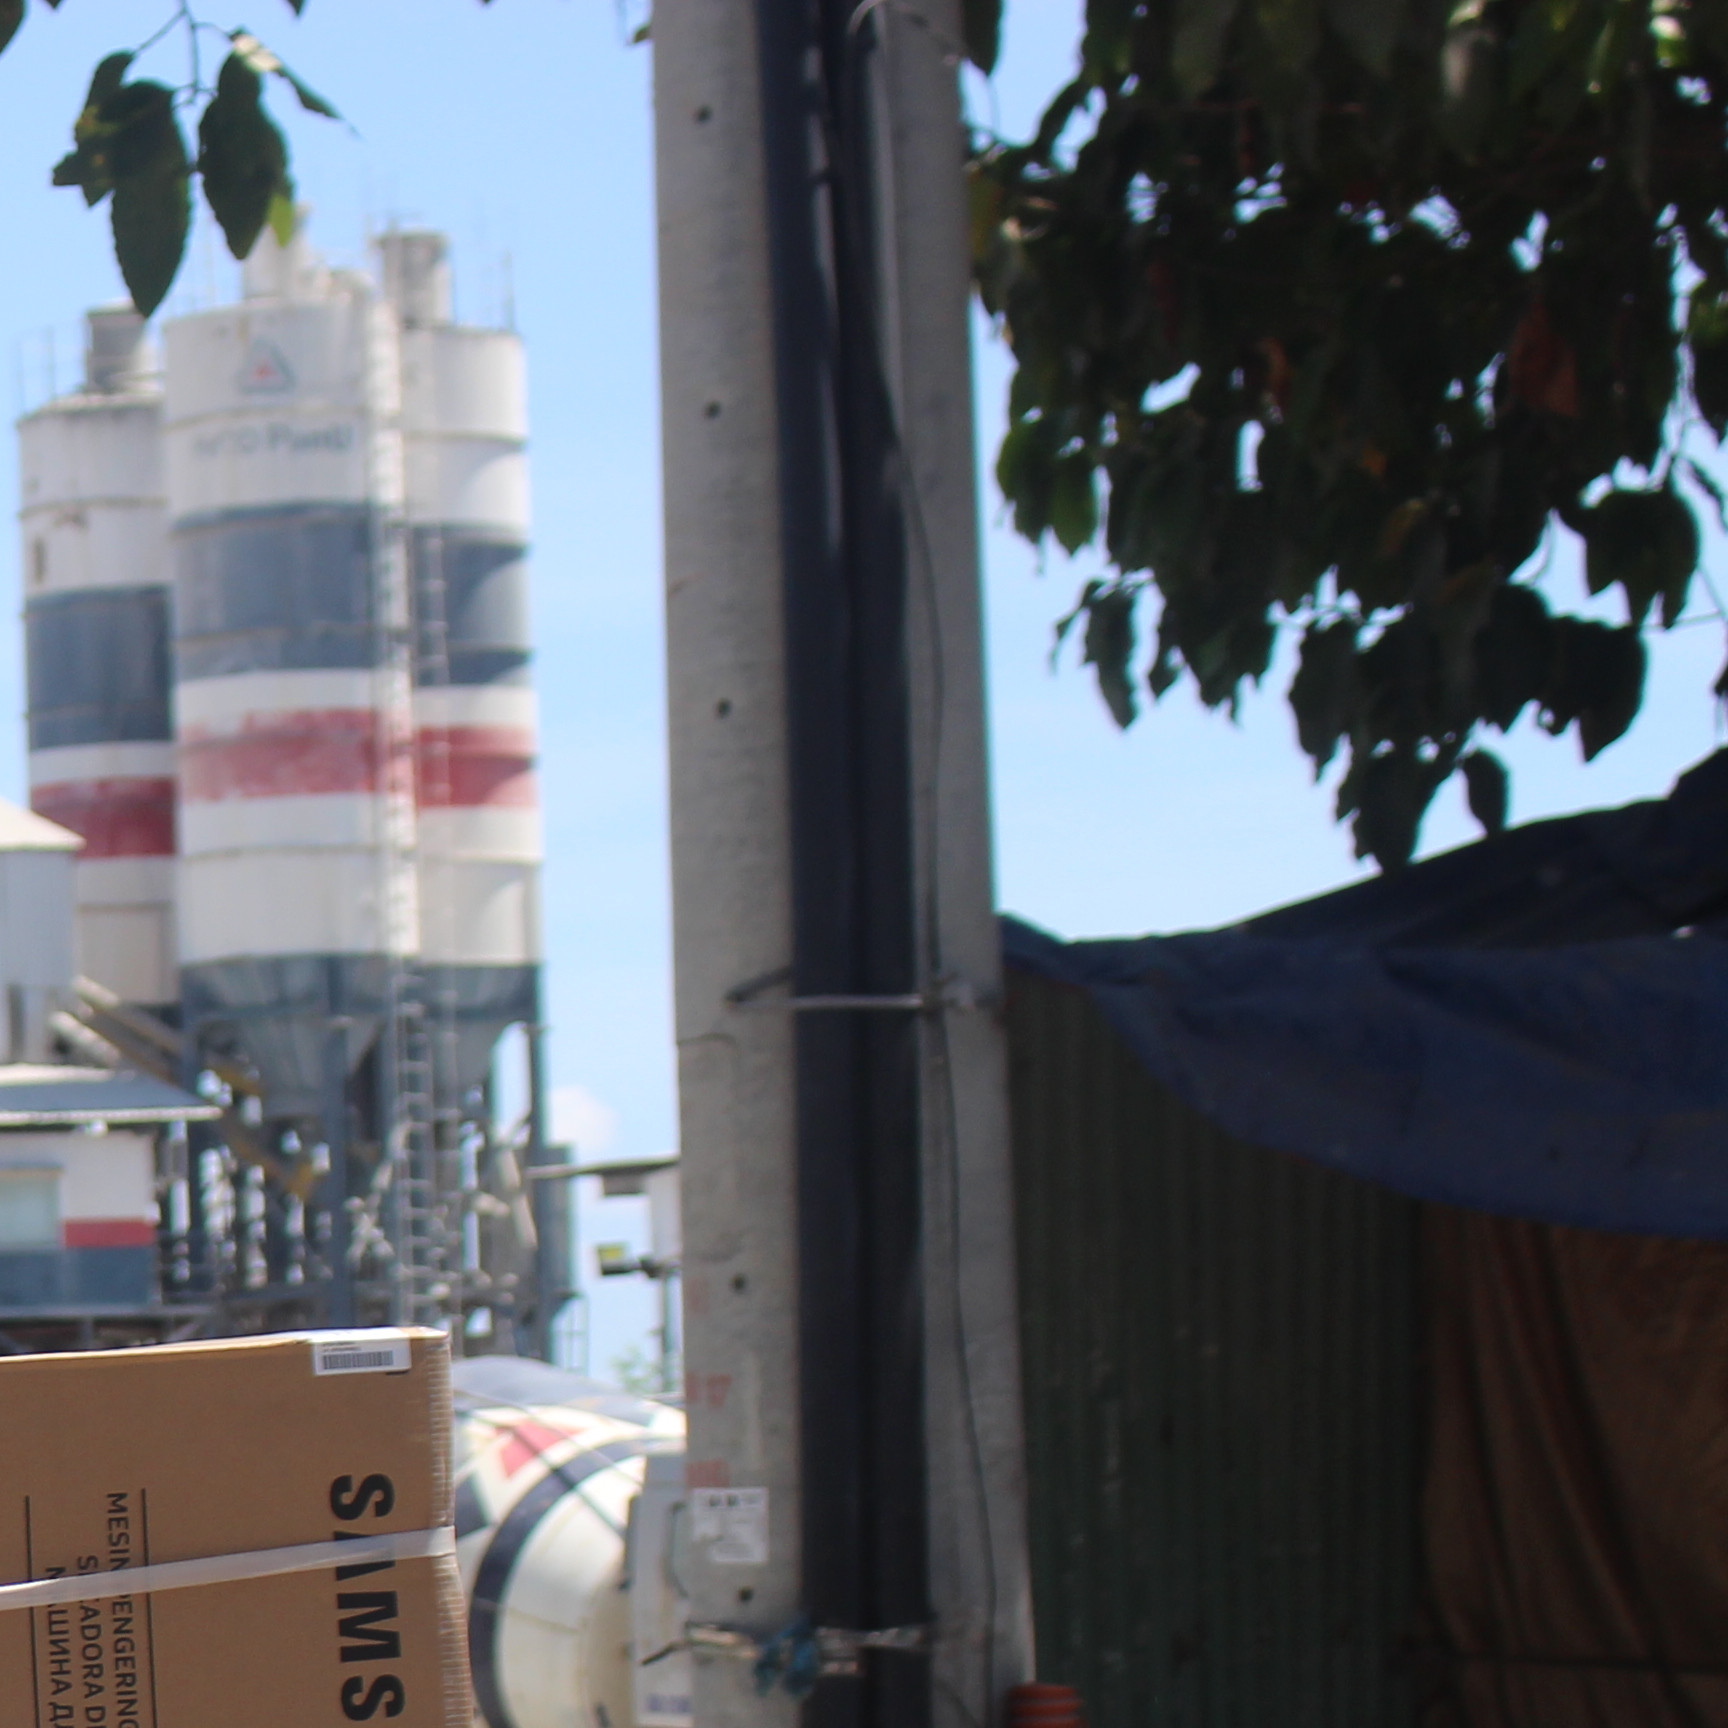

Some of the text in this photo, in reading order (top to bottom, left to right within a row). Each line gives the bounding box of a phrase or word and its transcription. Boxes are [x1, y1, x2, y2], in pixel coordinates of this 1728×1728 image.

[107, 1491, 131, 1571] MESIN
[45, 1566, 73, 1696] МШИНА
[77, 1555, 105, 1699] SADORA
